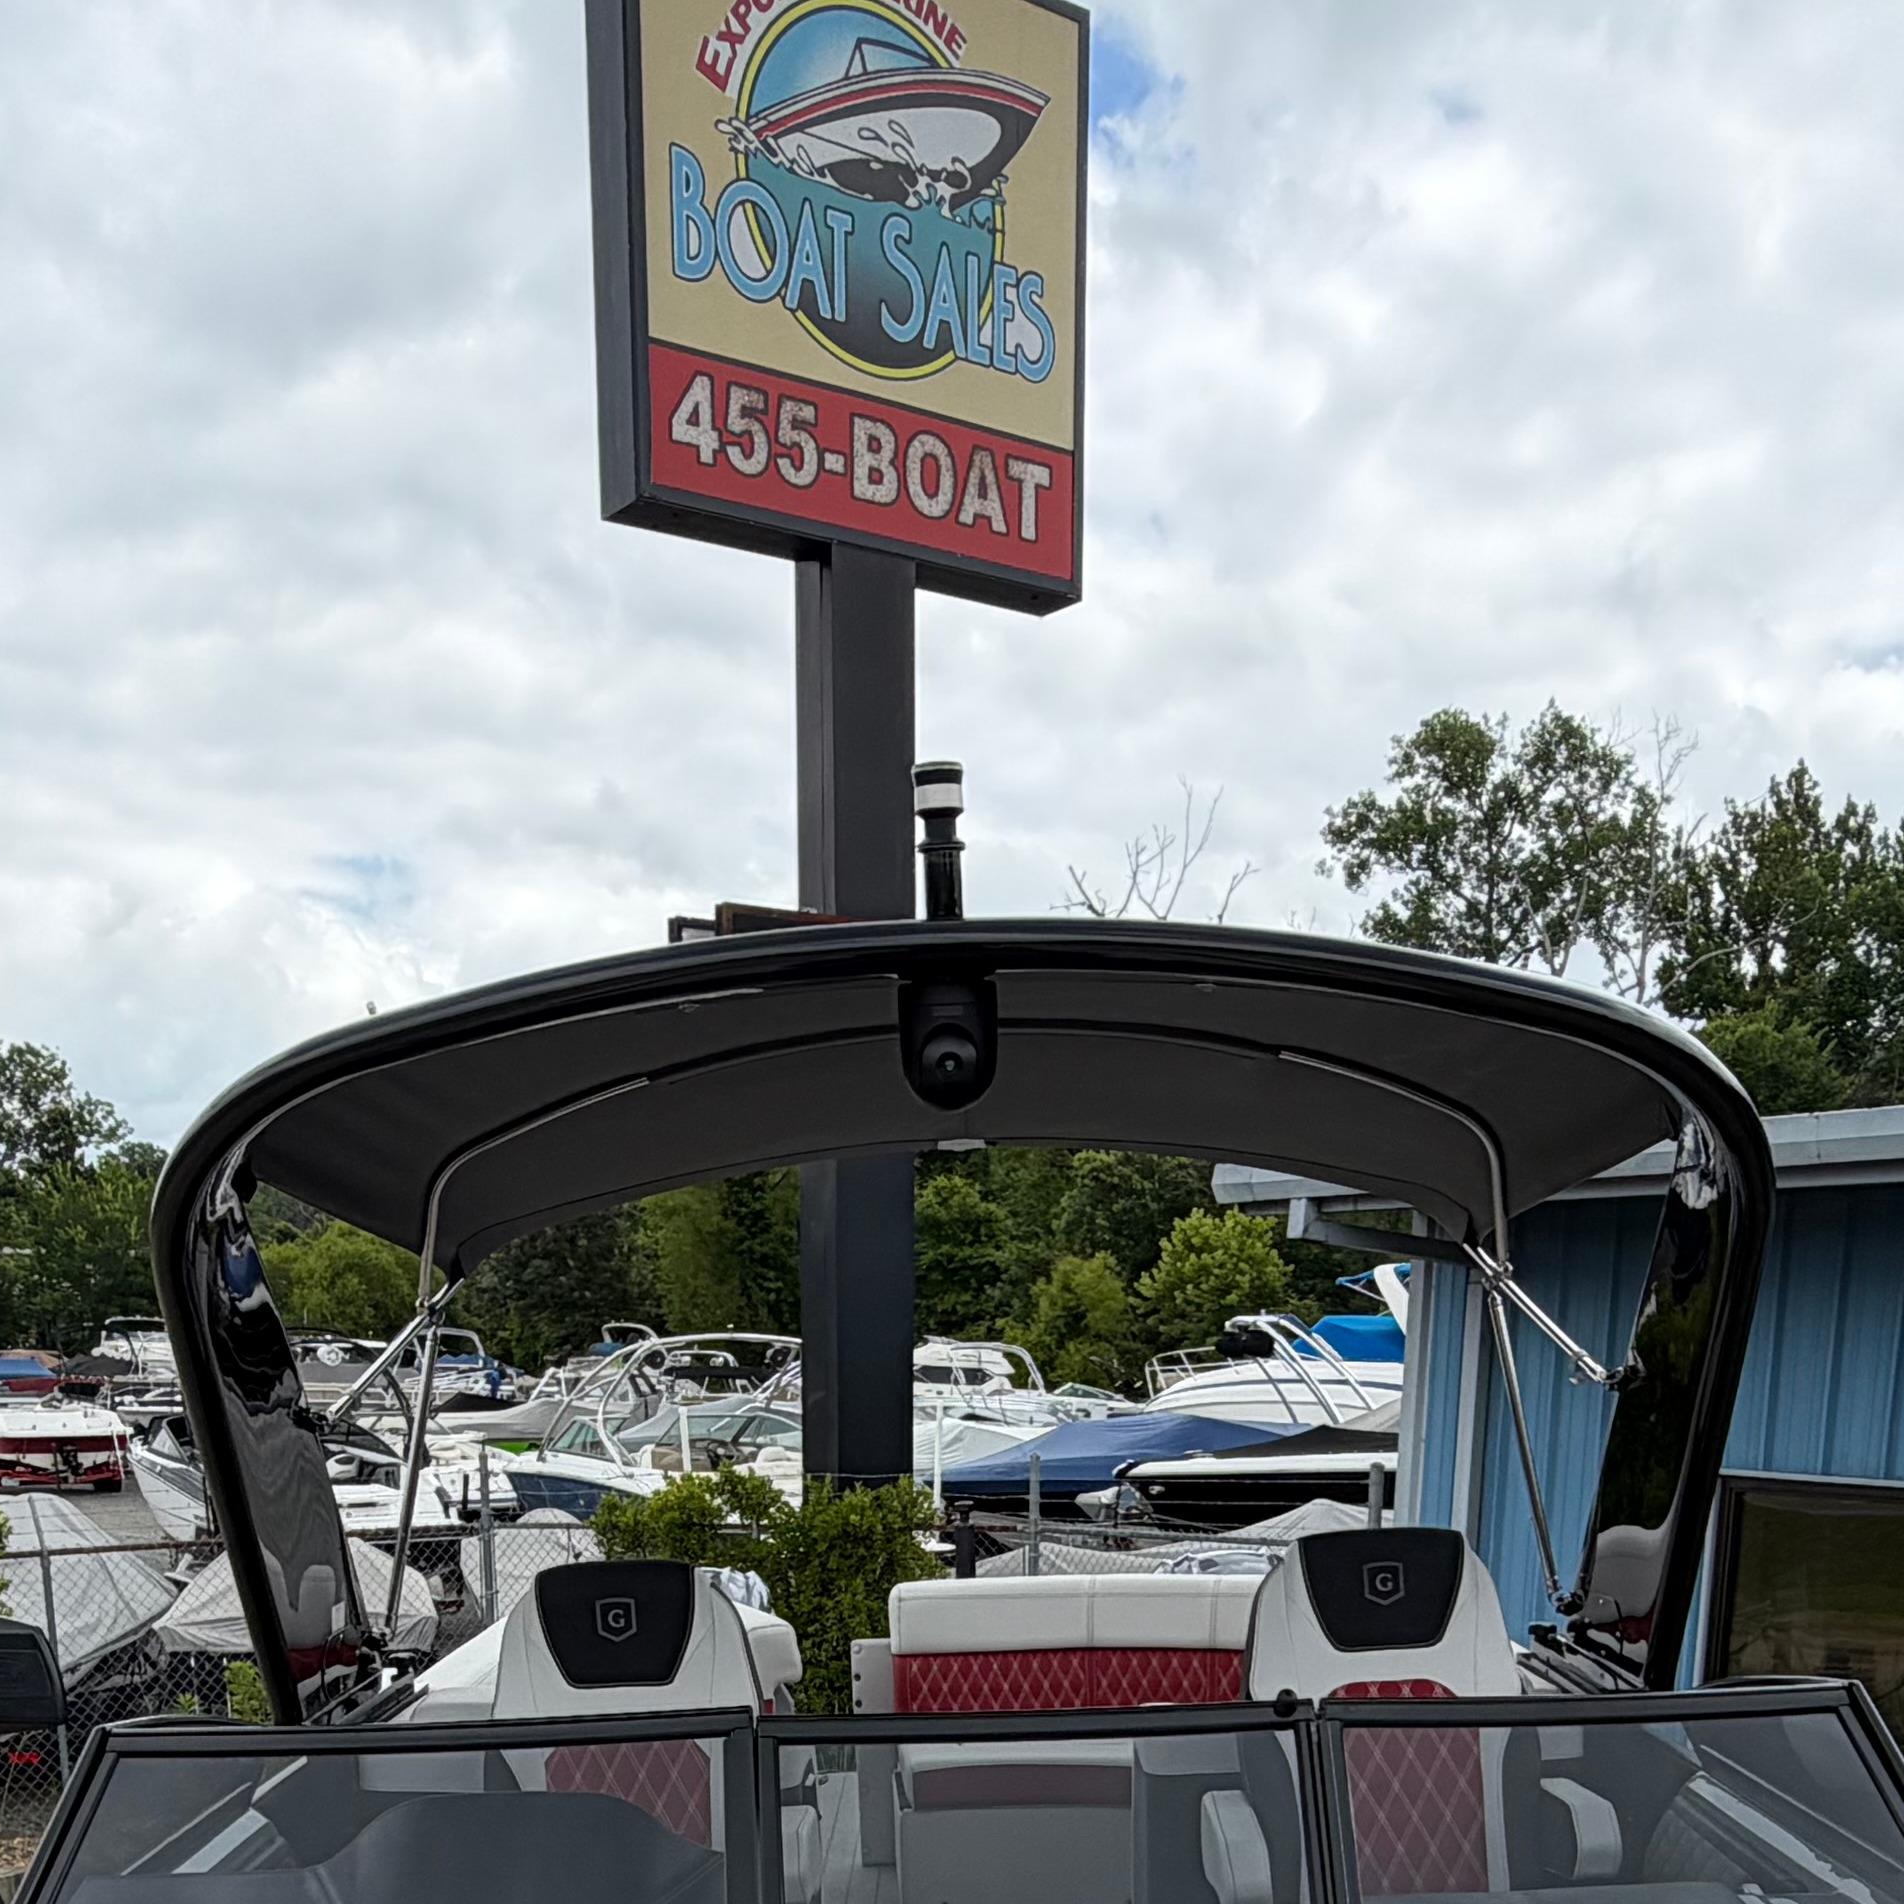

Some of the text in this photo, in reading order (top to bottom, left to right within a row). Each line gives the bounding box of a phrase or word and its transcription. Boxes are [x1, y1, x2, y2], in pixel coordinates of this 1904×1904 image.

[669, 142, 1055, 383] BOAT SALES
[670, 370, 1052, 542] 455-BOAT
[607, 1609, 625, 1628] G
[1376, 1573, 1393, 1591] G
